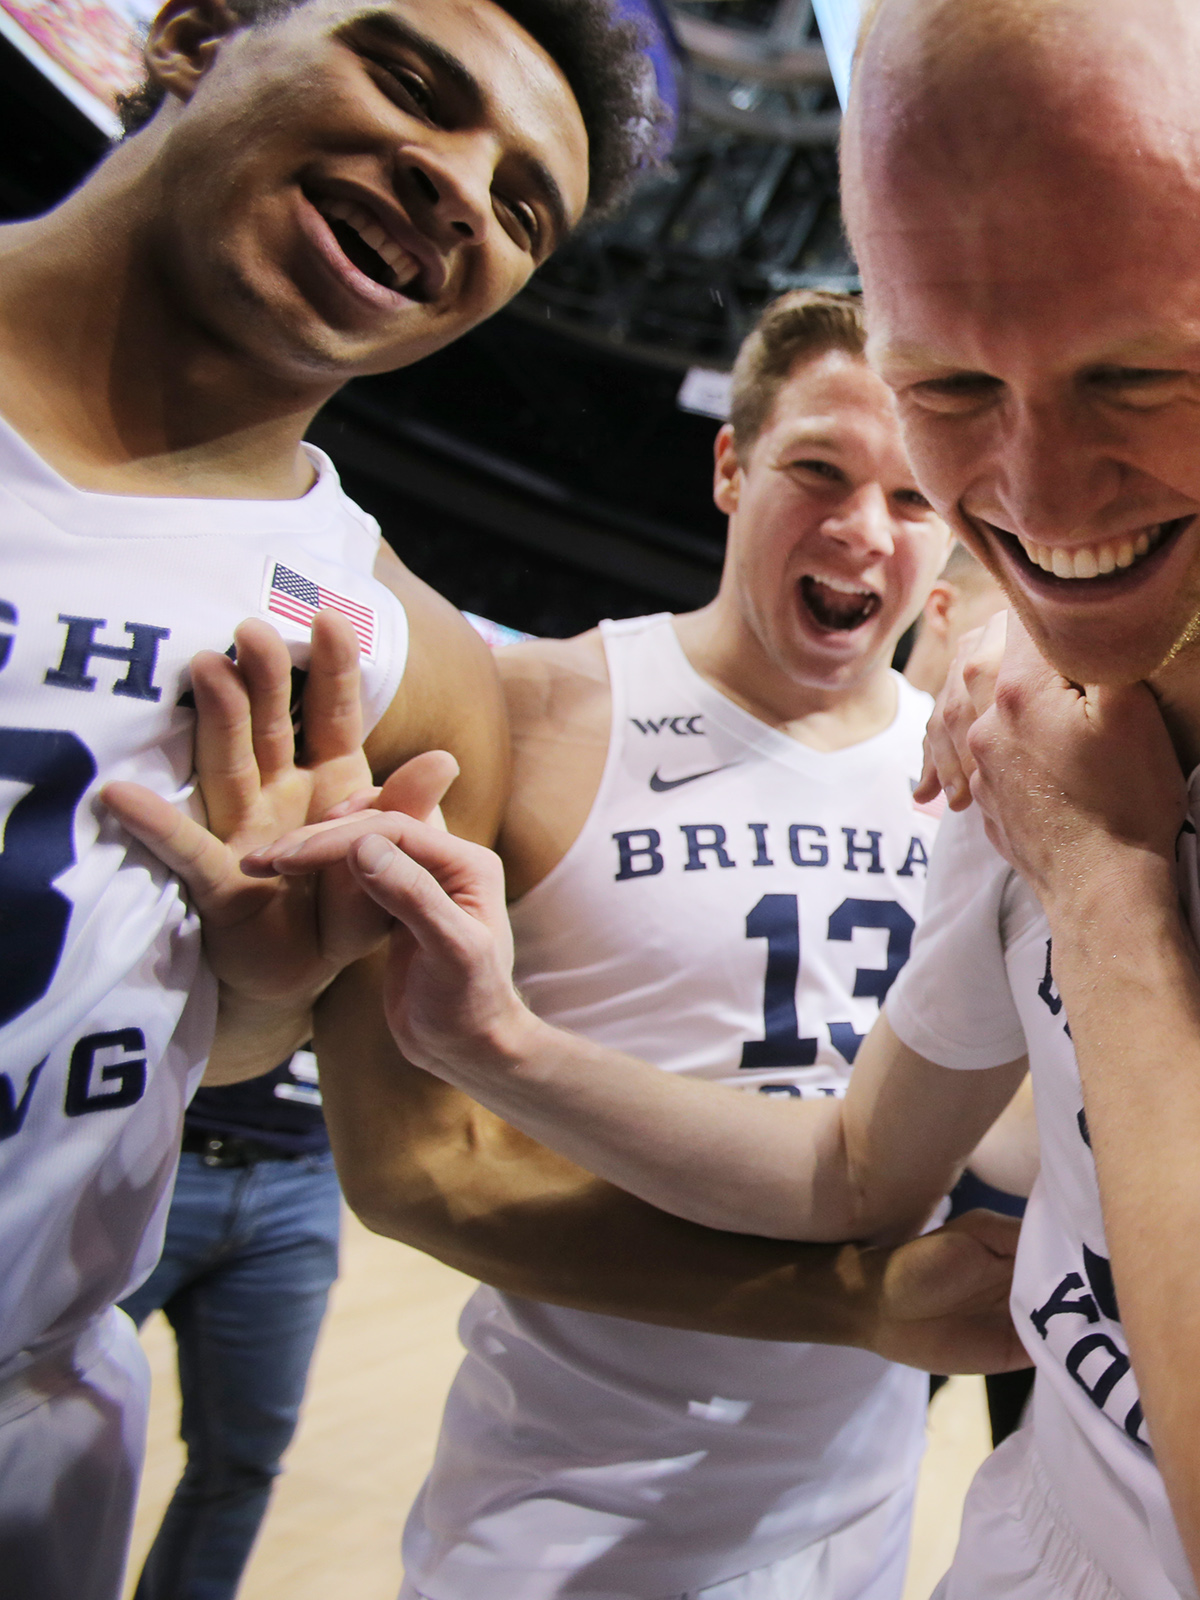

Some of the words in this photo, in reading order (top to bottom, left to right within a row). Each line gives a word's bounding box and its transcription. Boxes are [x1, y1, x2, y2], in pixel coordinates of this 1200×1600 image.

[630, 714, 705, 736] WCC
[612, 824, 928, 881] BRIGHA
[739, 894, 917, 1069] 13
